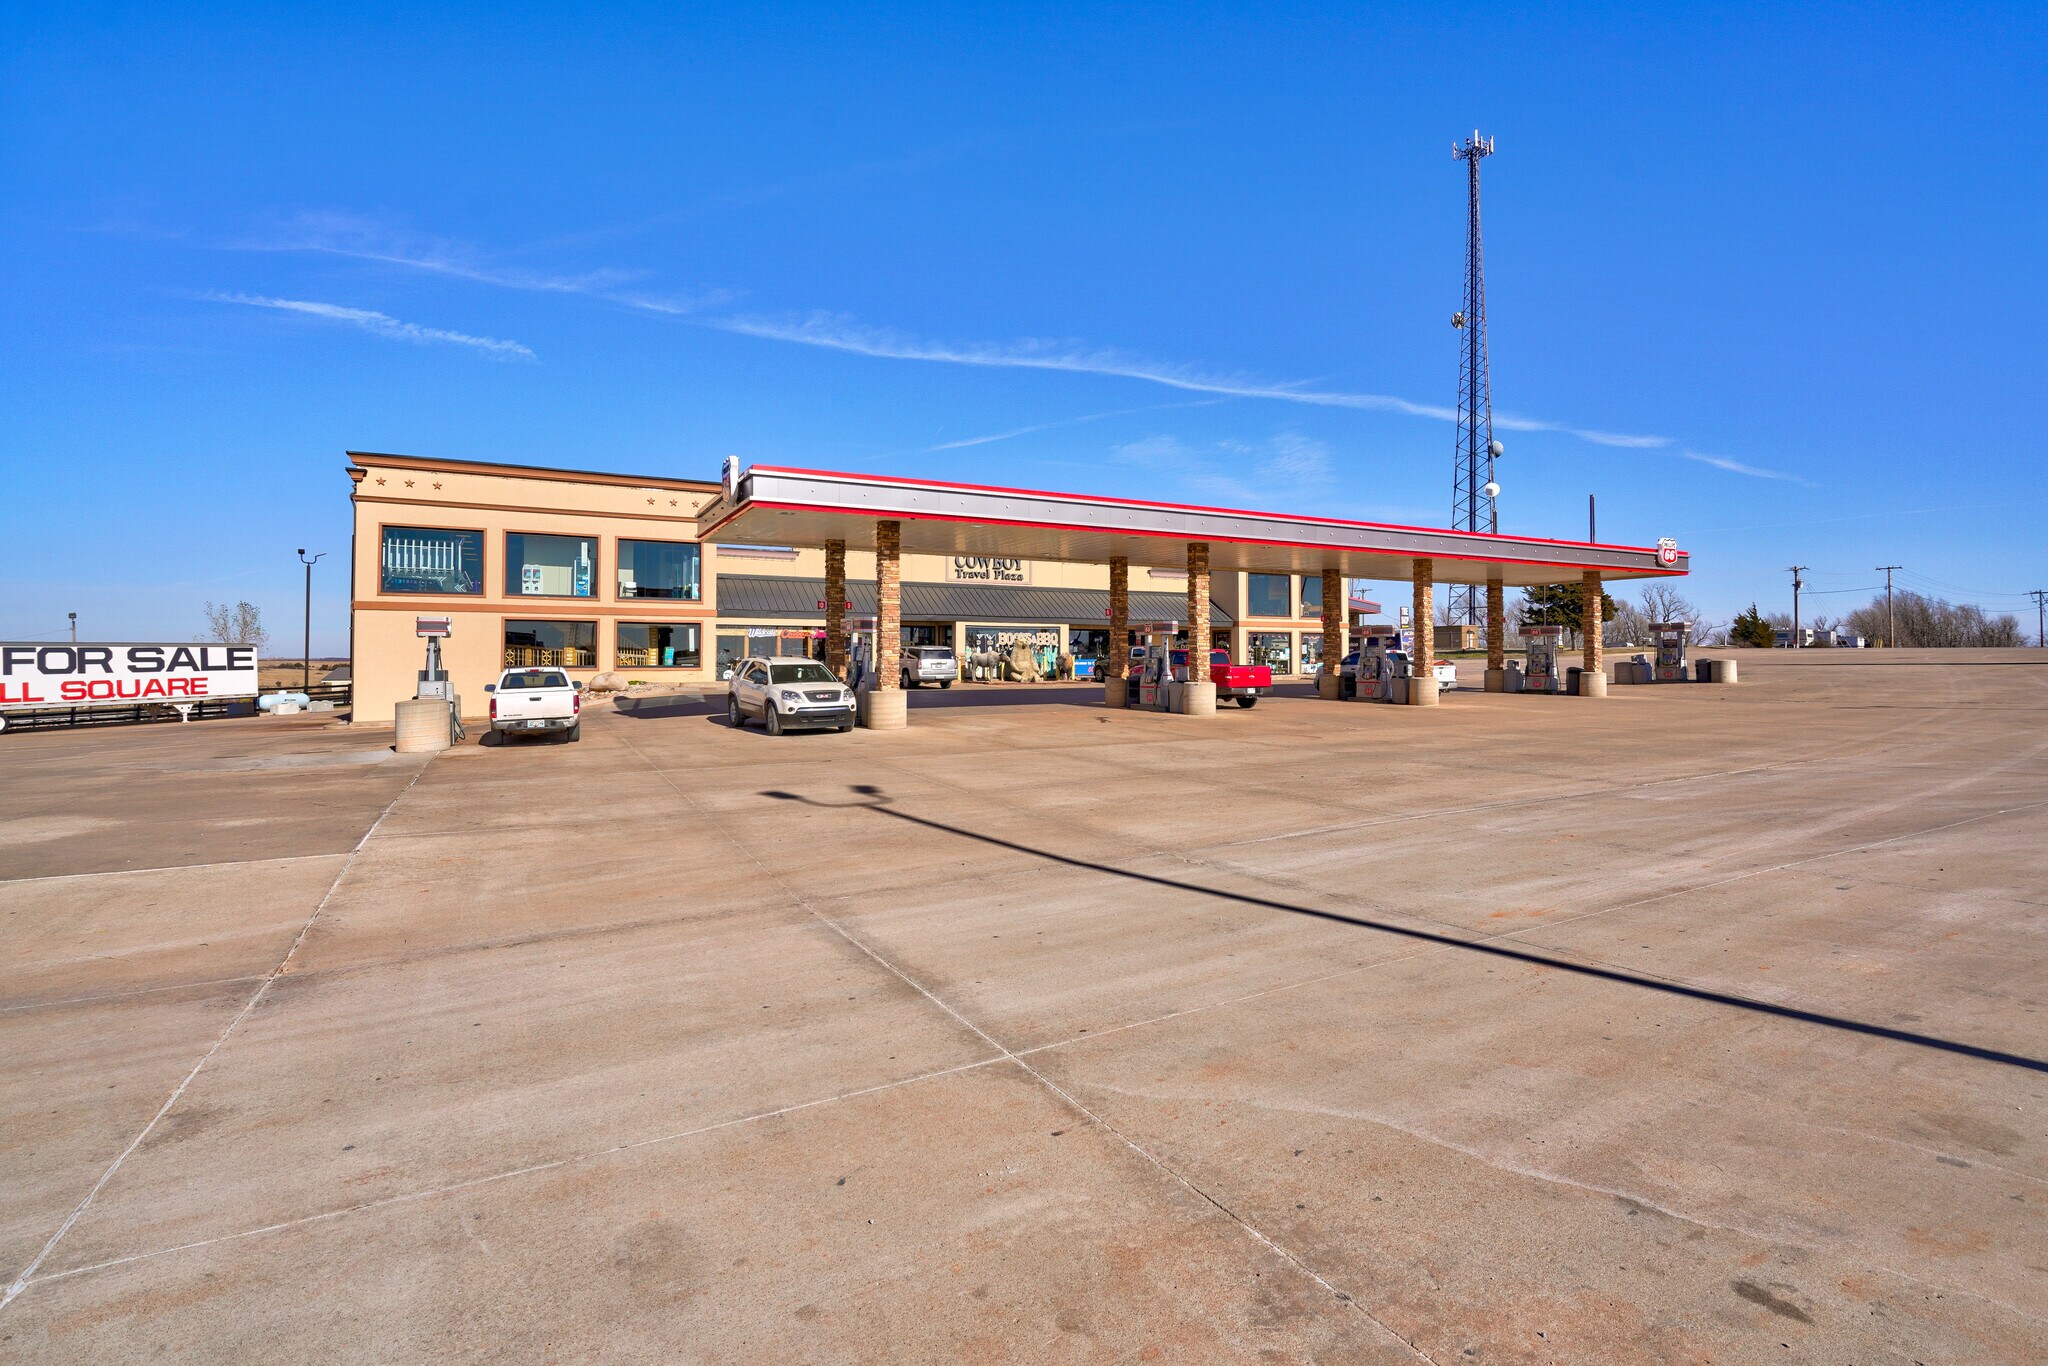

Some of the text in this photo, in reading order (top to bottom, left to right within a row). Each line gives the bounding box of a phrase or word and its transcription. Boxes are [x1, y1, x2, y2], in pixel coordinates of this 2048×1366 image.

[1665, 550, 1675, 560] 66
[954, 556, 1022, 571] COWBOY
[955, 569, 1024, 581] Travel Plaza
[3, 647, 254, 675] FOR SALE
[61, 677, 208, 701] SQUARE
